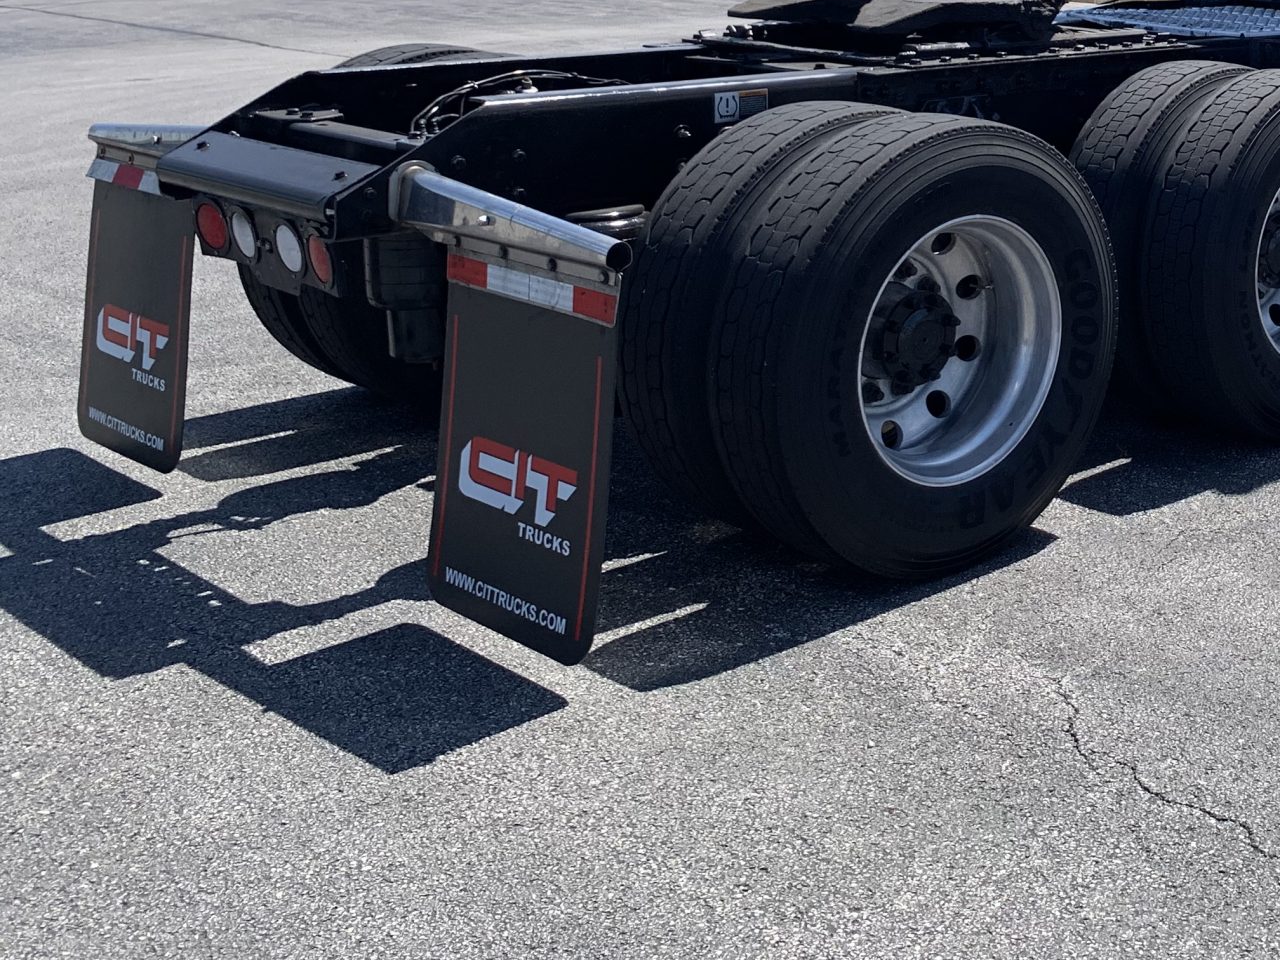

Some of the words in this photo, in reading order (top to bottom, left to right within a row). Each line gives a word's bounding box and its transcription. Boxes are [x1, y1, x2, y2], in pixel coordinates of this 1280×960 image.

[97, 303, 170, 371] CIT
[131, 368, 166, 392] TRUCKS
[88, 406, 165, 452] WWW.CITTRUCKS.COM
[458, 436, 578, 528] CIT
[517, 522, 571, 557] TRUCKS
[444, 566, 567, 636] WWW.CITTRUCKS.COM
